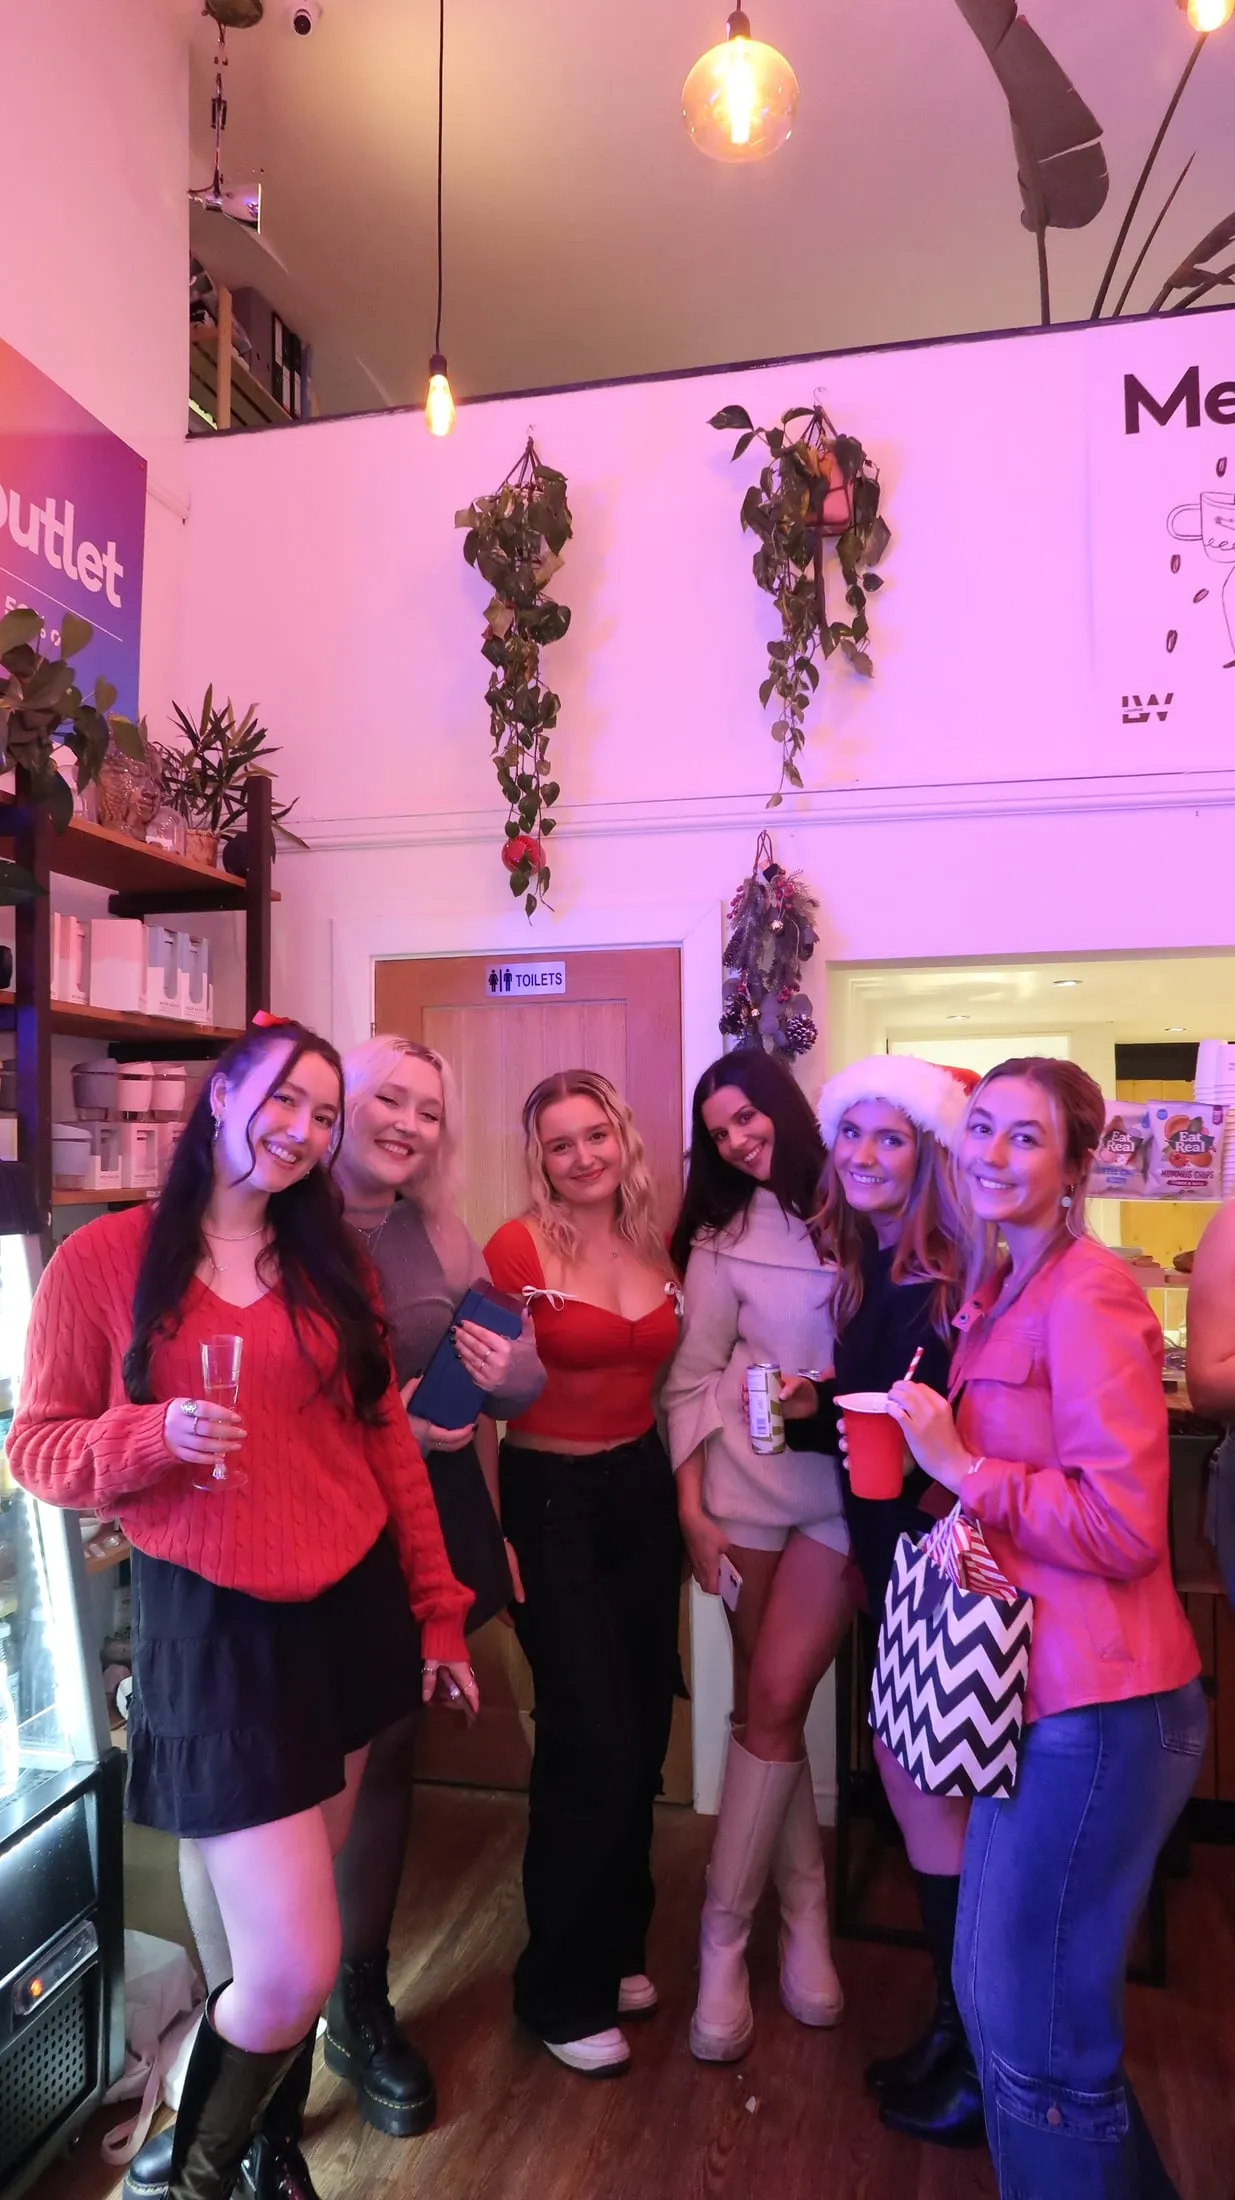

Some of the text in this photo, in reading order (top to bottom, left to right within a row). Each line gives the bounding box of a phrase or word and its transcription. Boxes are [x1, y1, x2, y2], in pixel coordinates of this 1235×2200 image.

[515, 972, 563, 988] TOILETS
[1112, 1131, 1132, 1142] Eat
[1179, 1131, 1202, 1142] Eat
[1107, 1140, 1135, 1153] Real
[1175, 1141, 1206, 1153] Real
